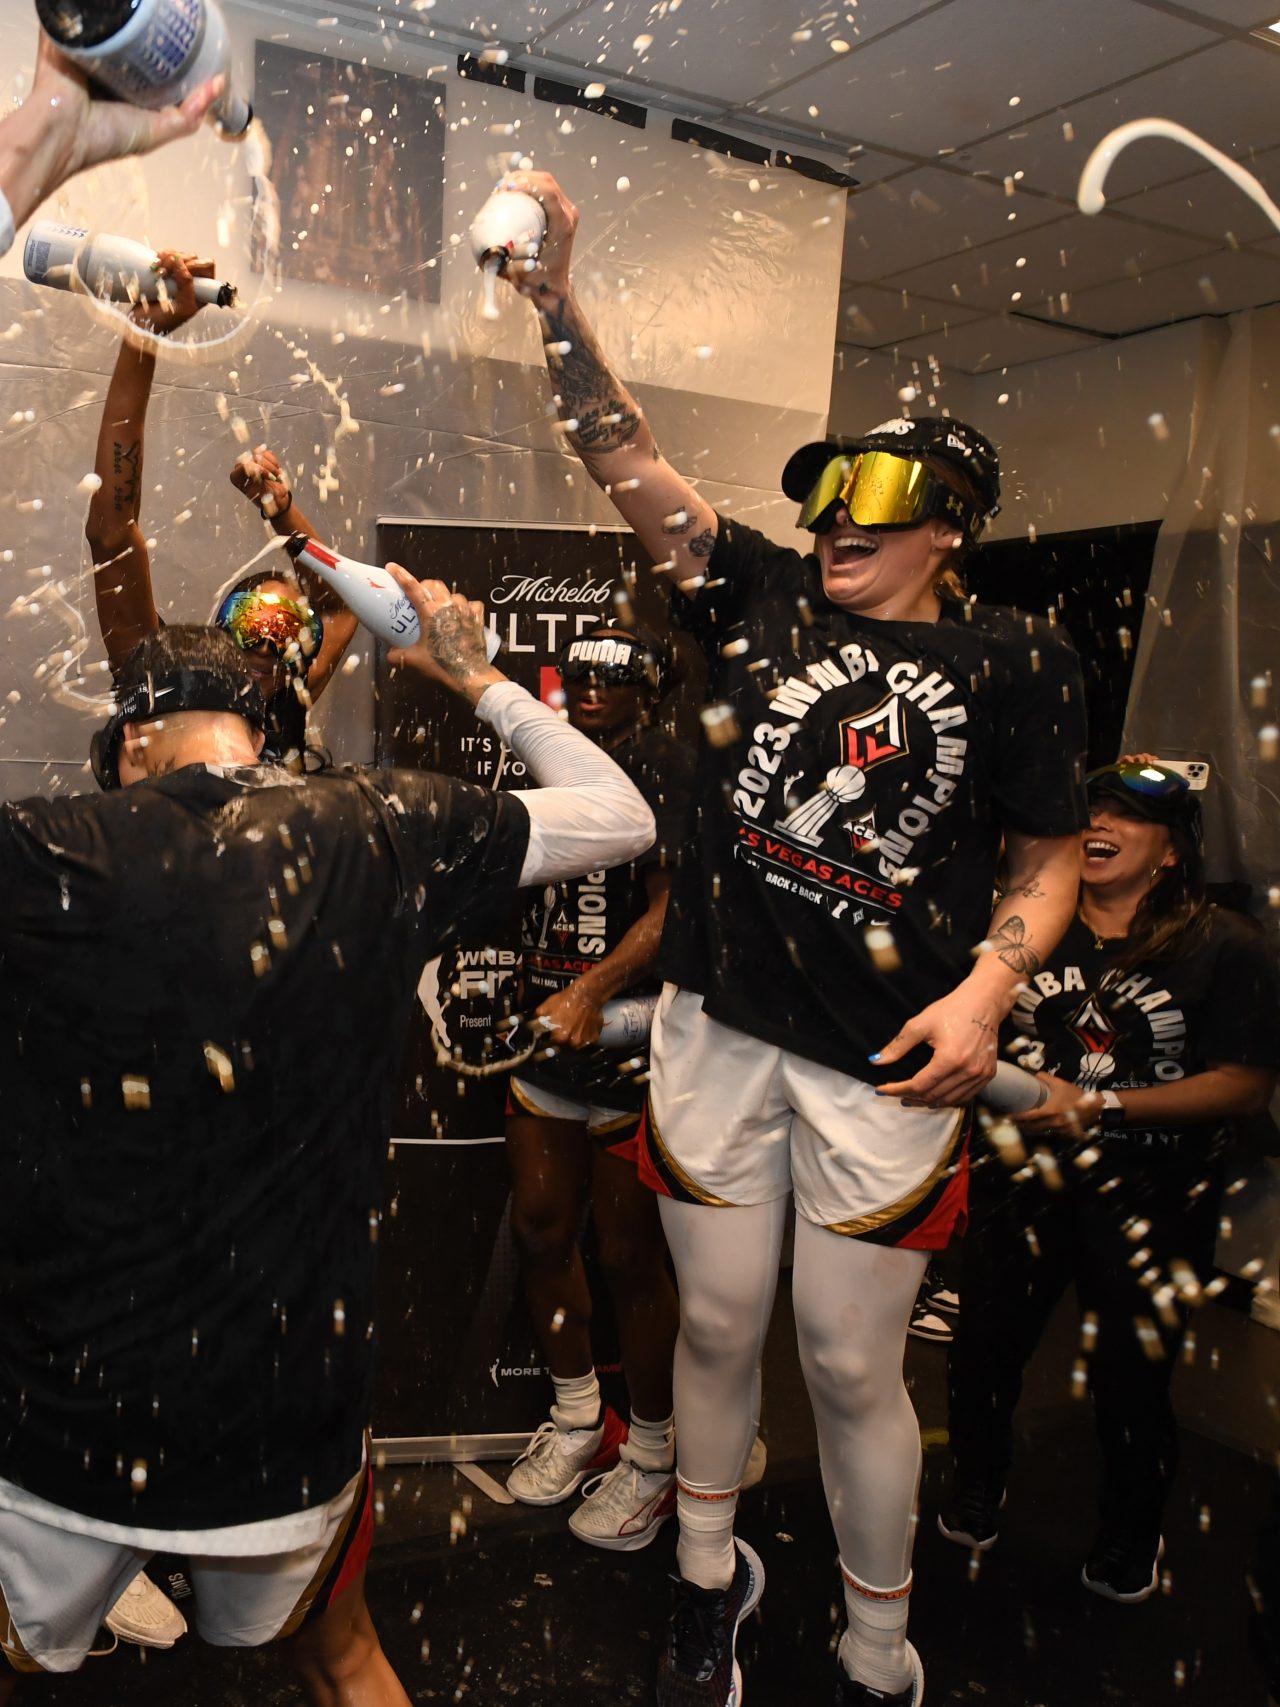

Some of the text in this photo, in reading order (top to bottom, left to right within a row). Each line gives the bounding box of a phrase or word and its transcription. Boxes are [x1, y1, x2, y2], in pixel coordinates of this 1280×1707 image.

[490, 575, 616, 604] Michelob
[568, 640, 632, 665] PUMA
[477, 761, 527, 776] IF YO
[733, 722, 791, 819] 2023
[765, 839, 834, 881] VEGAS
[835, 874, 903, 908] ACES
[765, 872, 792, 891] BACK
[799, 886, 823, 905] BACK
[501, 1367, 541, 1376] MORE
